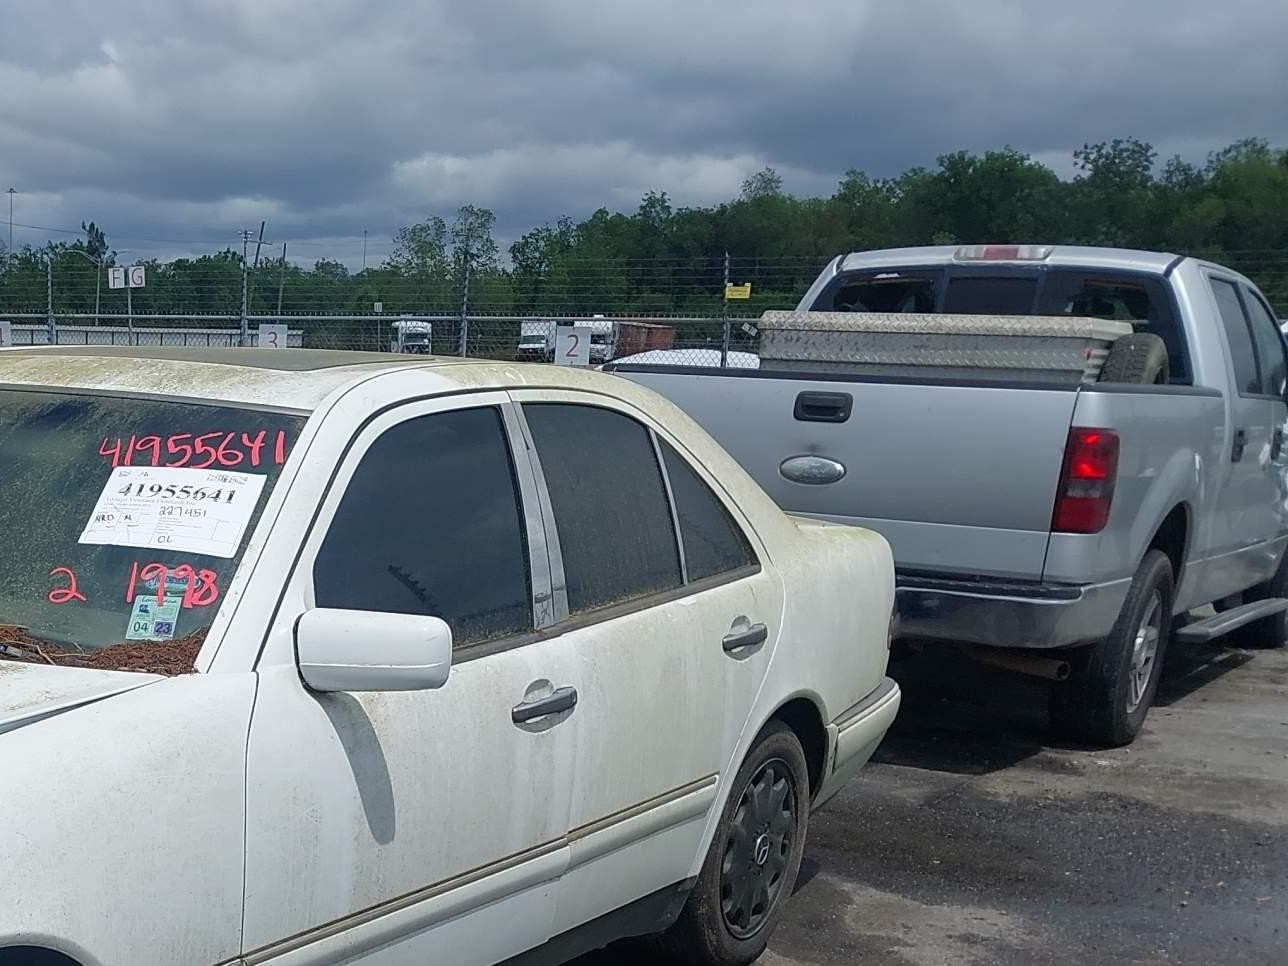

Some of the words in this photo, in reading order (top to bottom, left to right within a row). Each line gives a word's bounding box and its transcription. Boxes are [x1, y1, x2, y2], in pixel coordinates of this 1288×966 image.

[112, 270, 120, 287] F
[131, 268, 143, 286] G
[267, 331, 279, 348] 3
[566, 334, 579, 357] 2
[99, 431, 285, 468] 41955641
[118, 482, 236, 504] 41955641
[48, 567, 87, 603] 2
[126, 561, 219, 608] 1998
[133, 621, 148, 632] 04
[155, 622, 171, 634] 23
